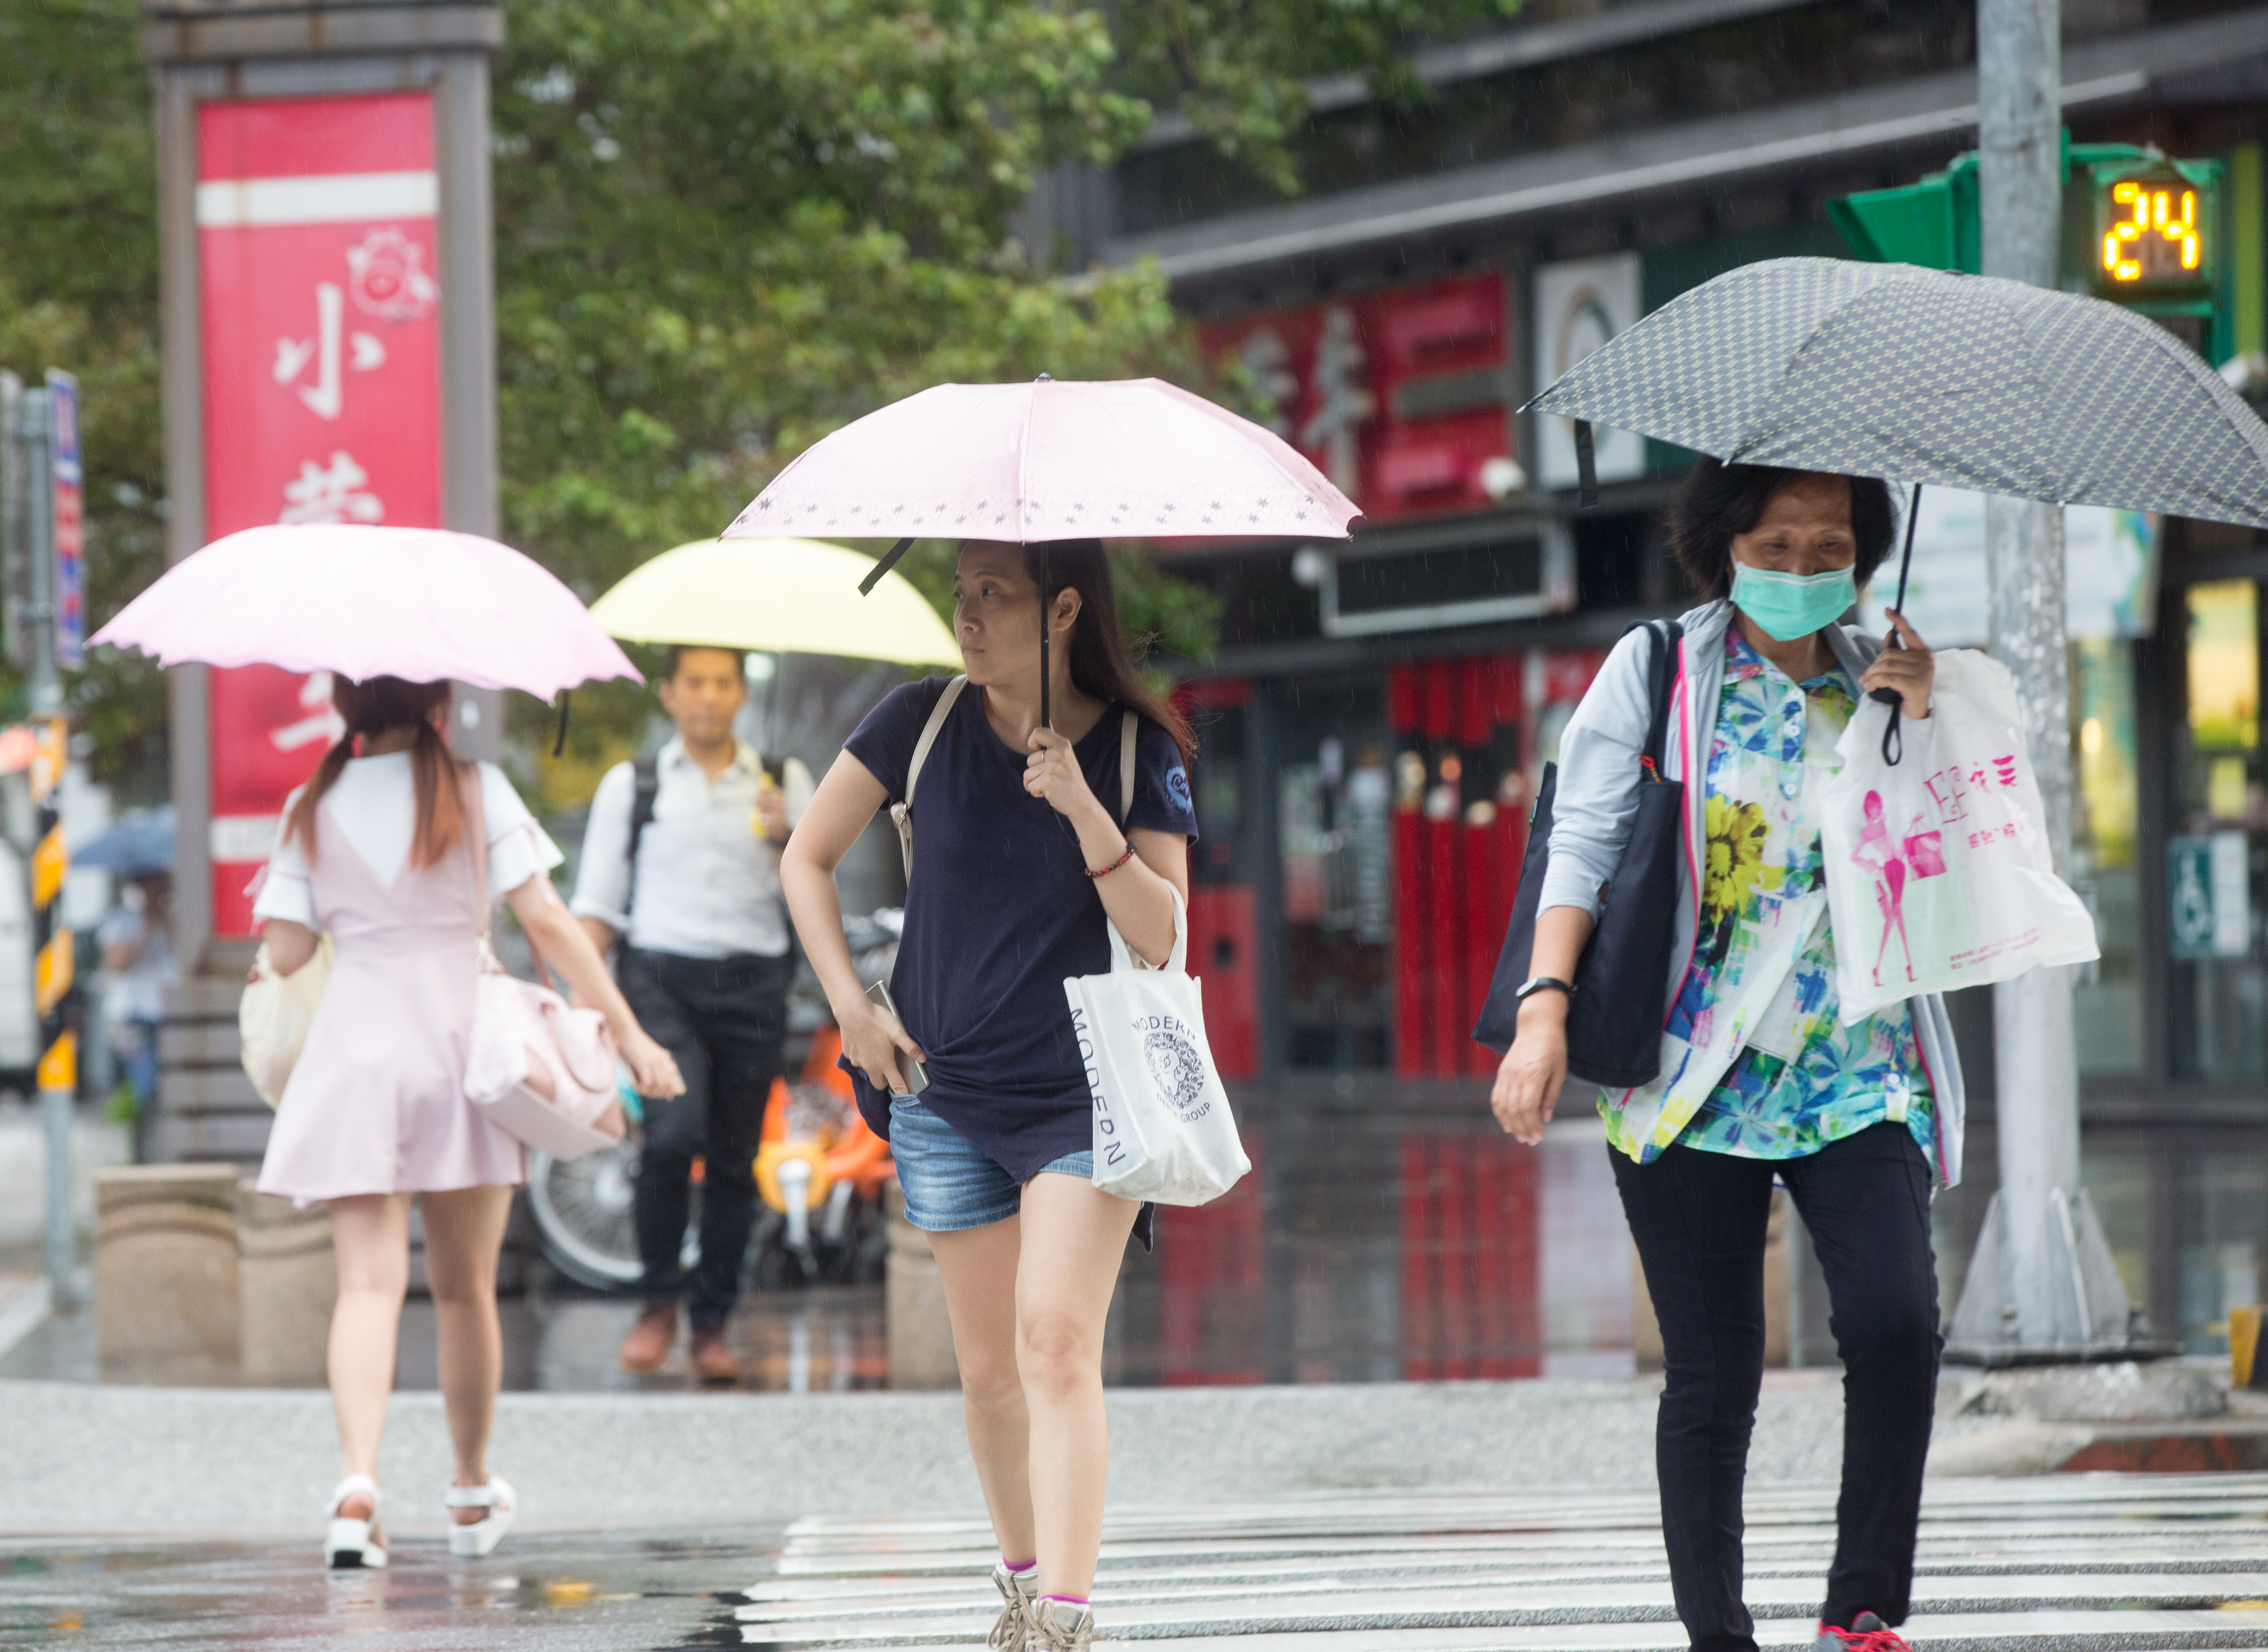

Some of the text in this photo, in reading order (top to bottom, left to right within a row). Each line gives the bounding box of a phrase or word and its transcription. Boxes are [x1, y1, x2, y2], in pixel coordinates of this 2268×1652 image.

[2103, 182, 2198, 281] 24
[1132, 1015, 1196, 1041] MODERN
[1181, 1101, 1211, 1123] GROUP
